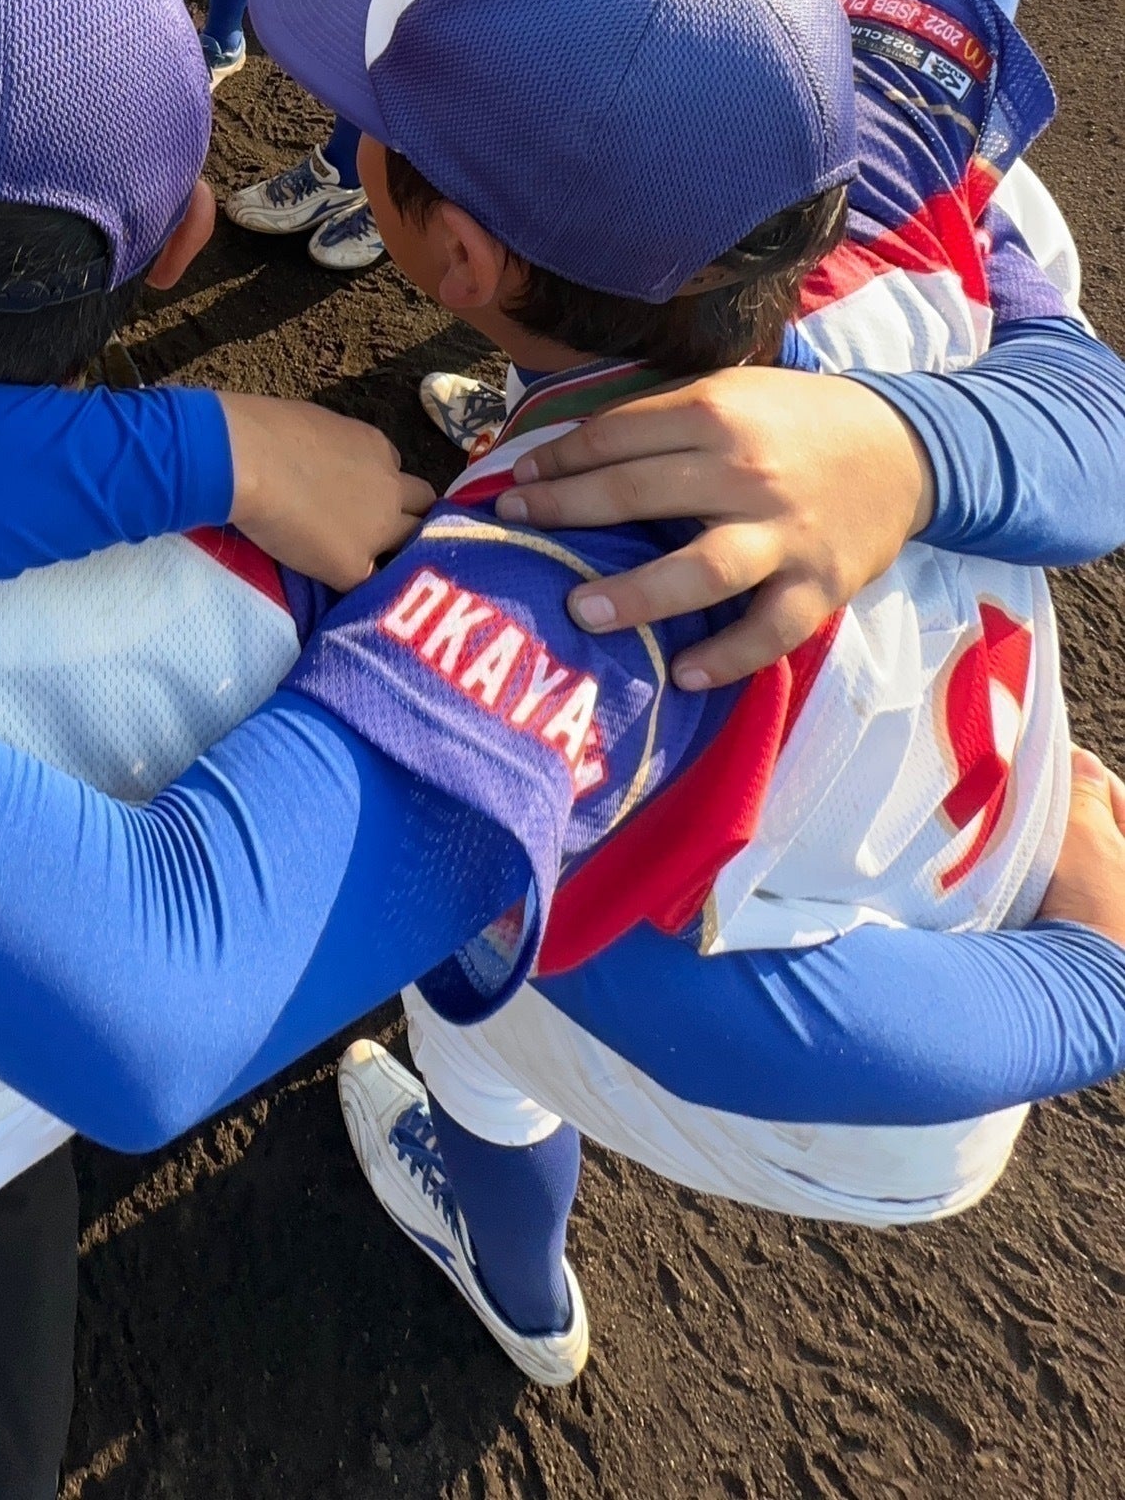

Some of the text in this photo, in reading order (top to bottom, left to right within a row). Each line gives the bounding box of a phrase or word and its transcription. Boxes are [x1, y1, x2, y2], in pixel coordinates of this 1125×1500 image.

[872, 0, 923, 25] JSBB
[925, 14, 965, 47] 2022
[380, 567, 605, 795] OKAYA
